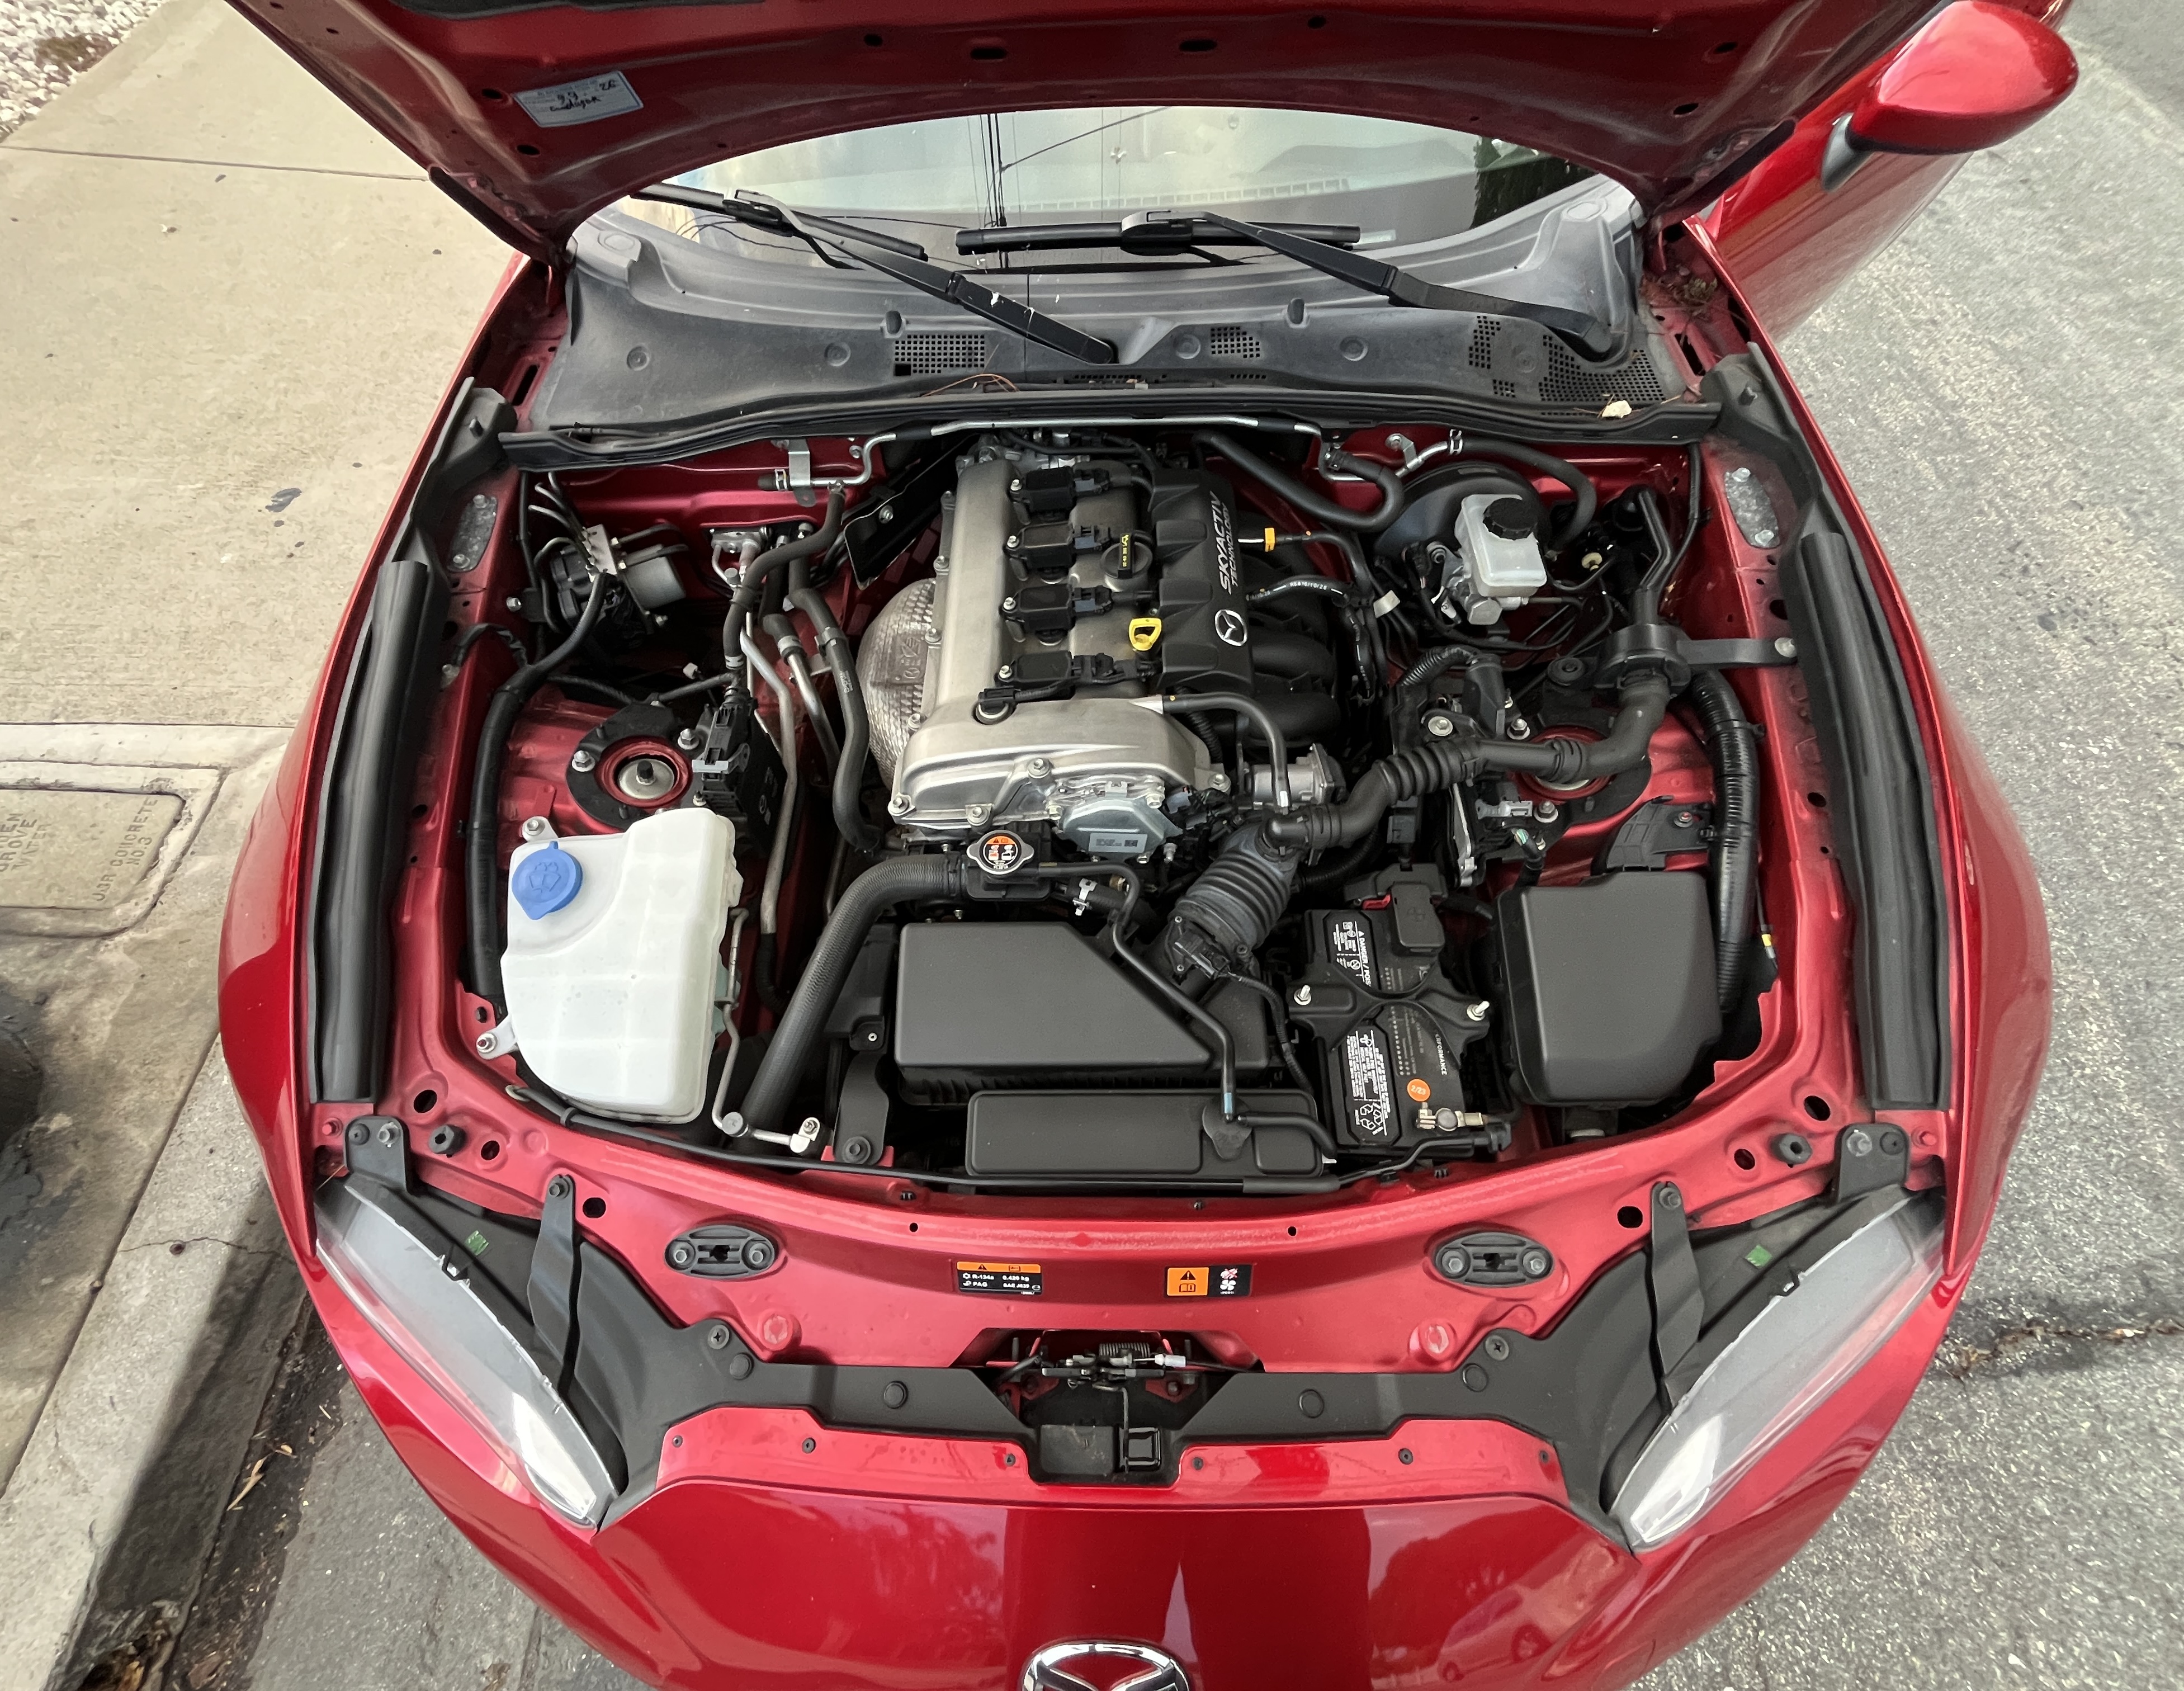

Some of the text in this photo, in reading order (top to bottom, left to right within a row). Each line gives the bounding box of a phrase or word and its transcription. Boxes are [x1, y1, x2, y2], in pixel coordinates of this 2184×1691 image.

[1210, 490, 1231, 594] SKYACTIV
[1222, 502, 1238, 587] TECHNOLOGY
[110, 796, 158, 866] CONCRETE
[1359, 937, 1369, 964] DANGER
[1411, 1084, 1426, 1095] 2/23
